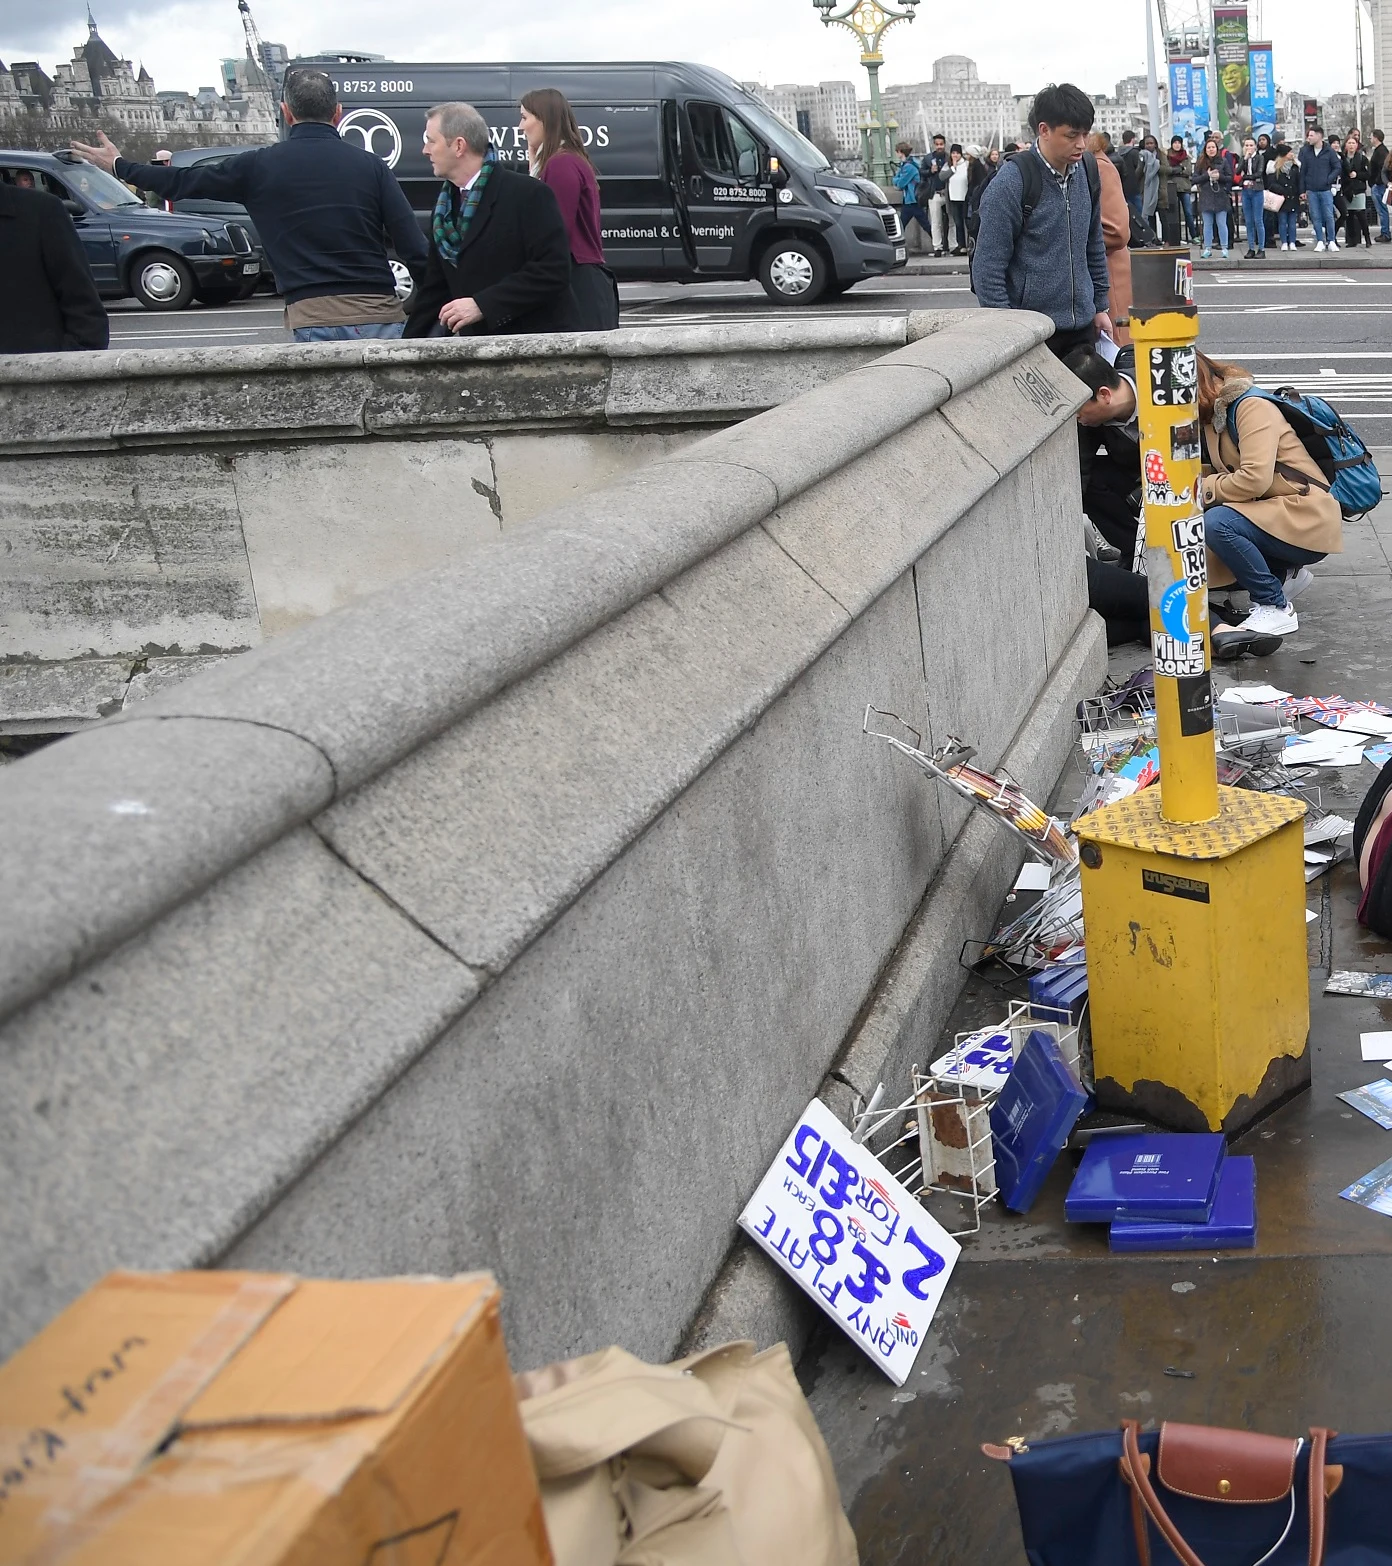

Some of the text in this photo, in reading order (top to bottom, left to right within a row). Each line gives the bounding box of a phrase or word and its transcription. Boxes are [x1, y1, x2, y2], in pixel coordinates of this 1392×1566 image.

[343, 80, 376, 93] 8752
[380, 80, 414, 93] 8000
[713, 186, 767, 197] 020 8752 8000
[781, 192, 791, 200] 72
[600, 225, 658, 239] ernational
[660, 226, 670, 238] &
[785, 1124, 860, 1210] £15
[782, 1175, 891, 1304] £8 EACH
[847, 1216, 867, 1244] OR
[901, 1226, 946, 1301] 2
[754, 1204, 896, 1357] ANY PLATE
[885, 1317, 918, 1347] ONLY
